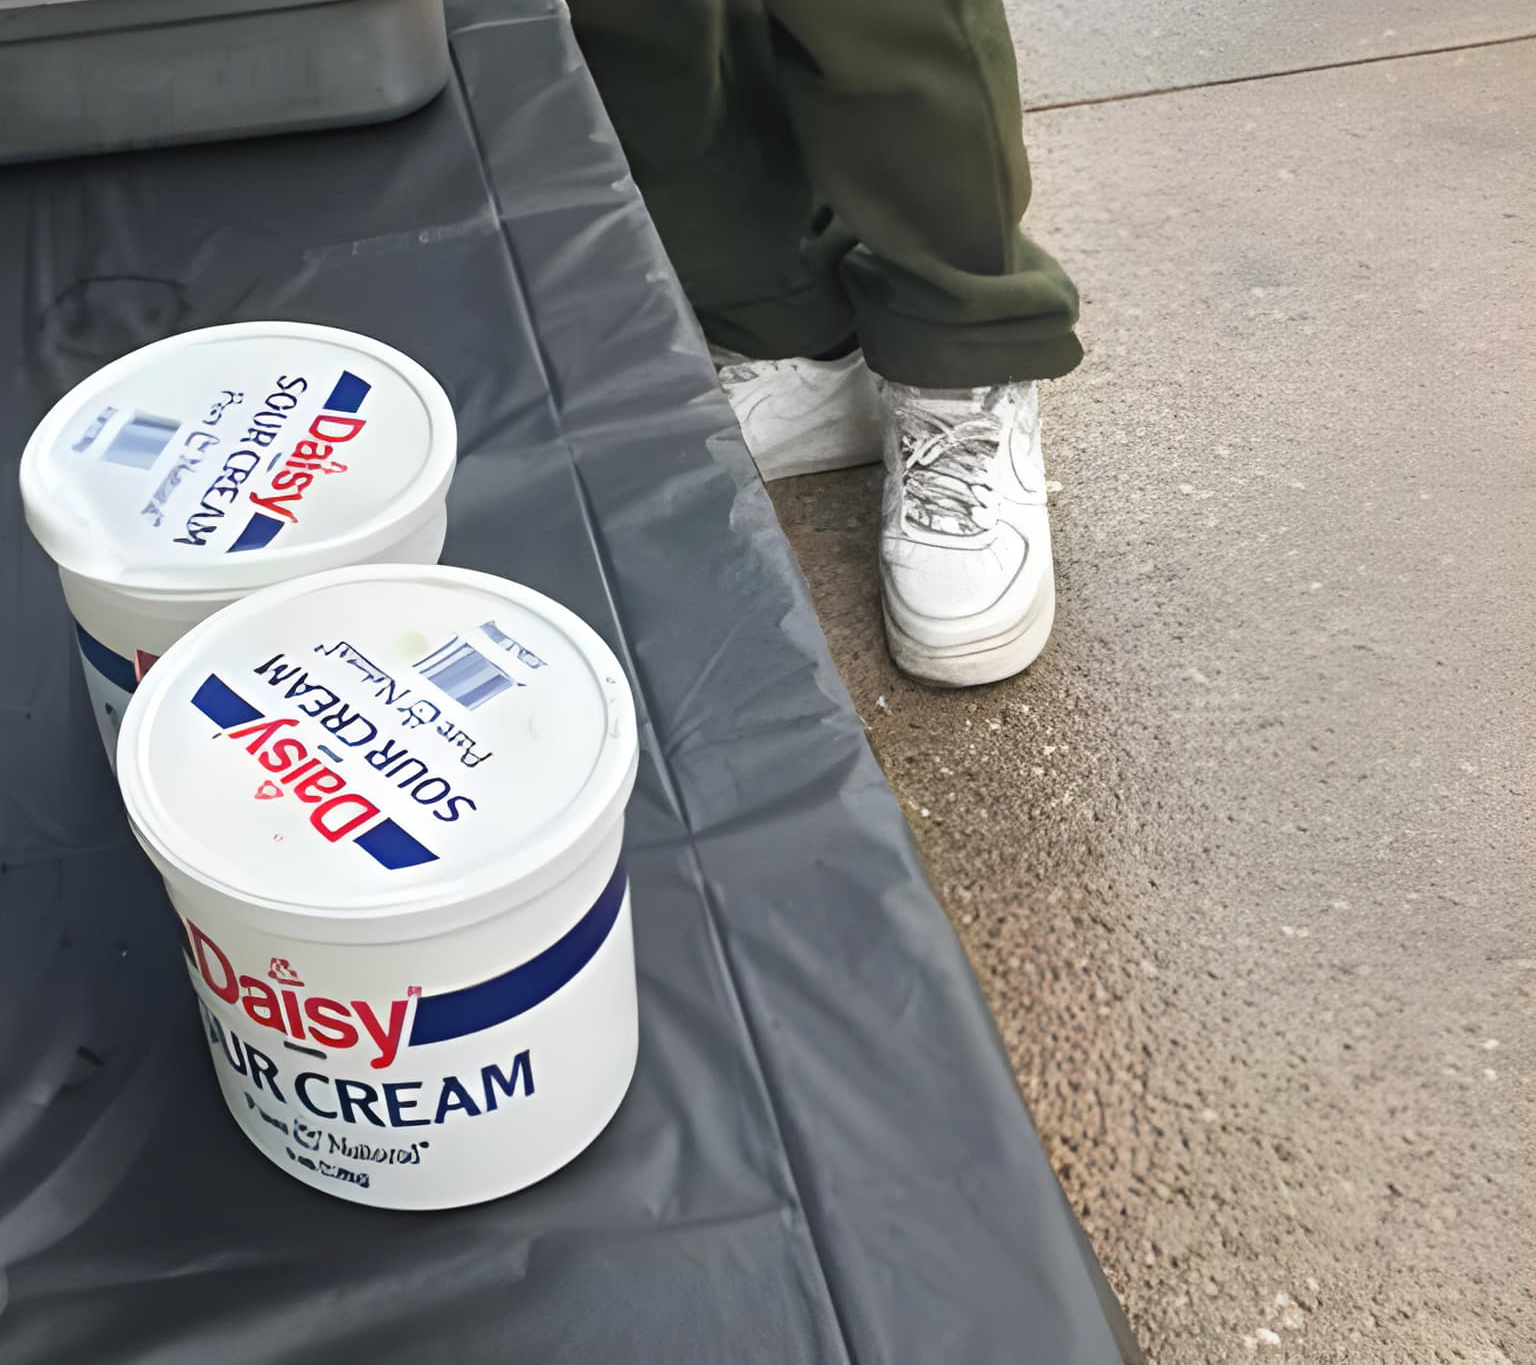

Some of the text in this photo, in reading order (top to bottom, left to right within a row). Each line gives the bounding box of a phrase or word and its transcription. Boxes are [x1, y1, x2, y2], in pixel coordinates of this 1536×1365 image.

[241, 375, 308, 447] SOUR
[250, 414, 366, 523] Daisy
[229, 718, 380, 842] Daisy
[253, 654, 477, 821] SOUR CREAM
[187, 918, 408, 1069] Daisy
[294, 1049, 535, 1127] CREAM
